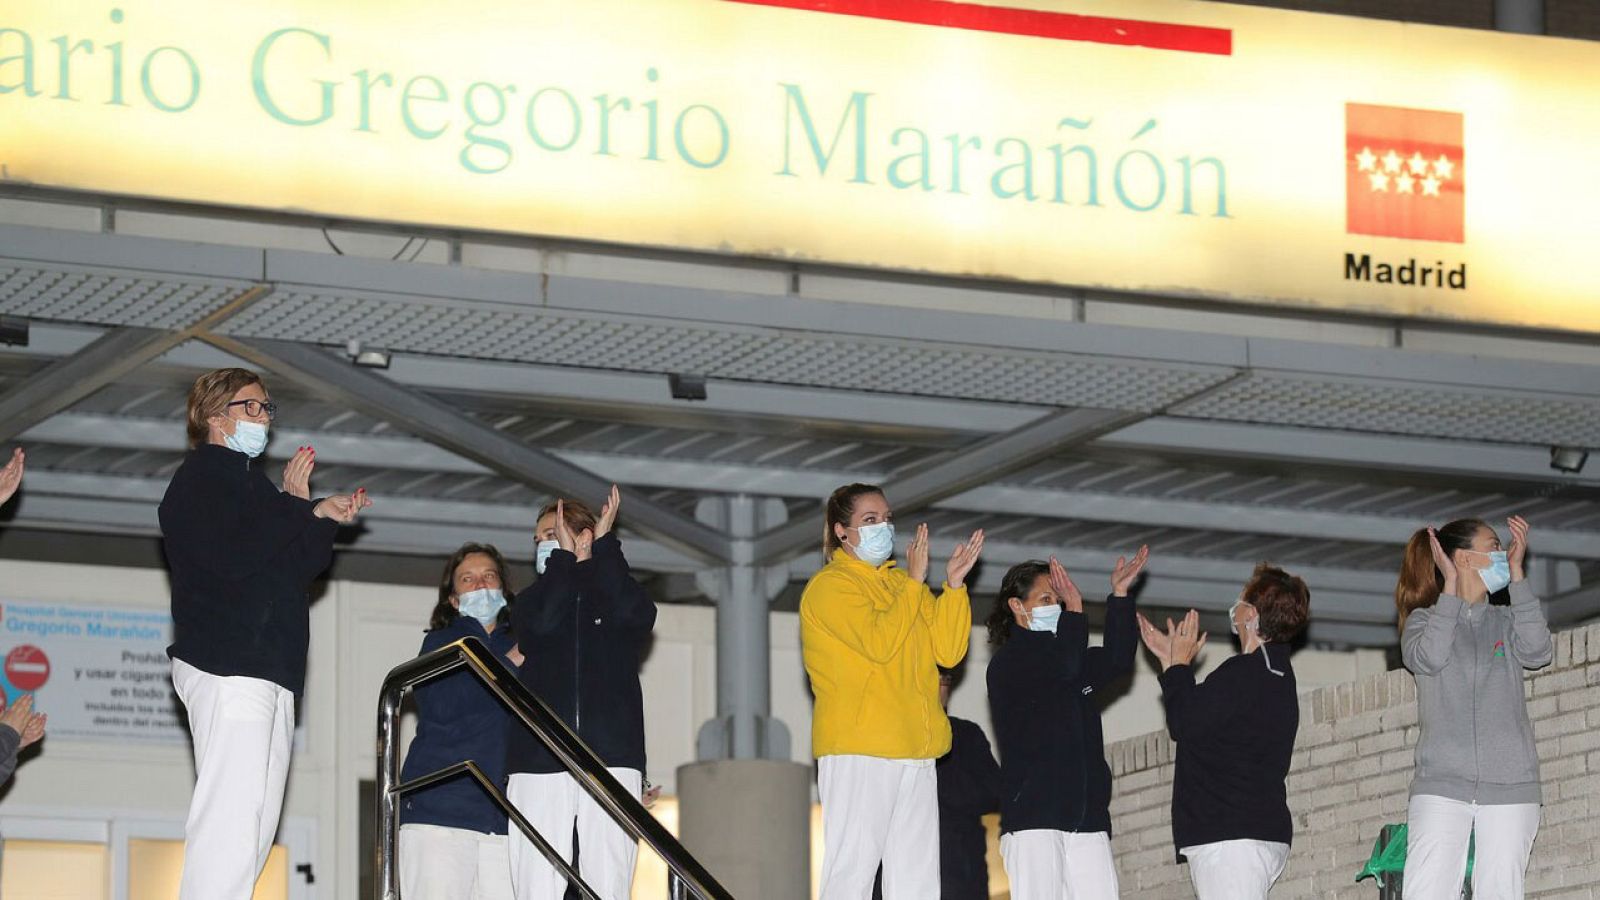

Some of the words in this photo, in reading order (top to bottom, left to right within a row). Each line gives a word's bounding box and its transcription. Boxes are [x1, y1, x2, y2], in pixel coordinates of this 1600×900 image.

[250, 27, 730, 174] Gregorio
[773, 82, 1235, 219] Marañón
[1344, 253, 1466, 290] Madrid
[6, 615, 81, 637] Gregorio
[87, 621, 161, 639] Marañón
[86, 669, 117, 680] usar
